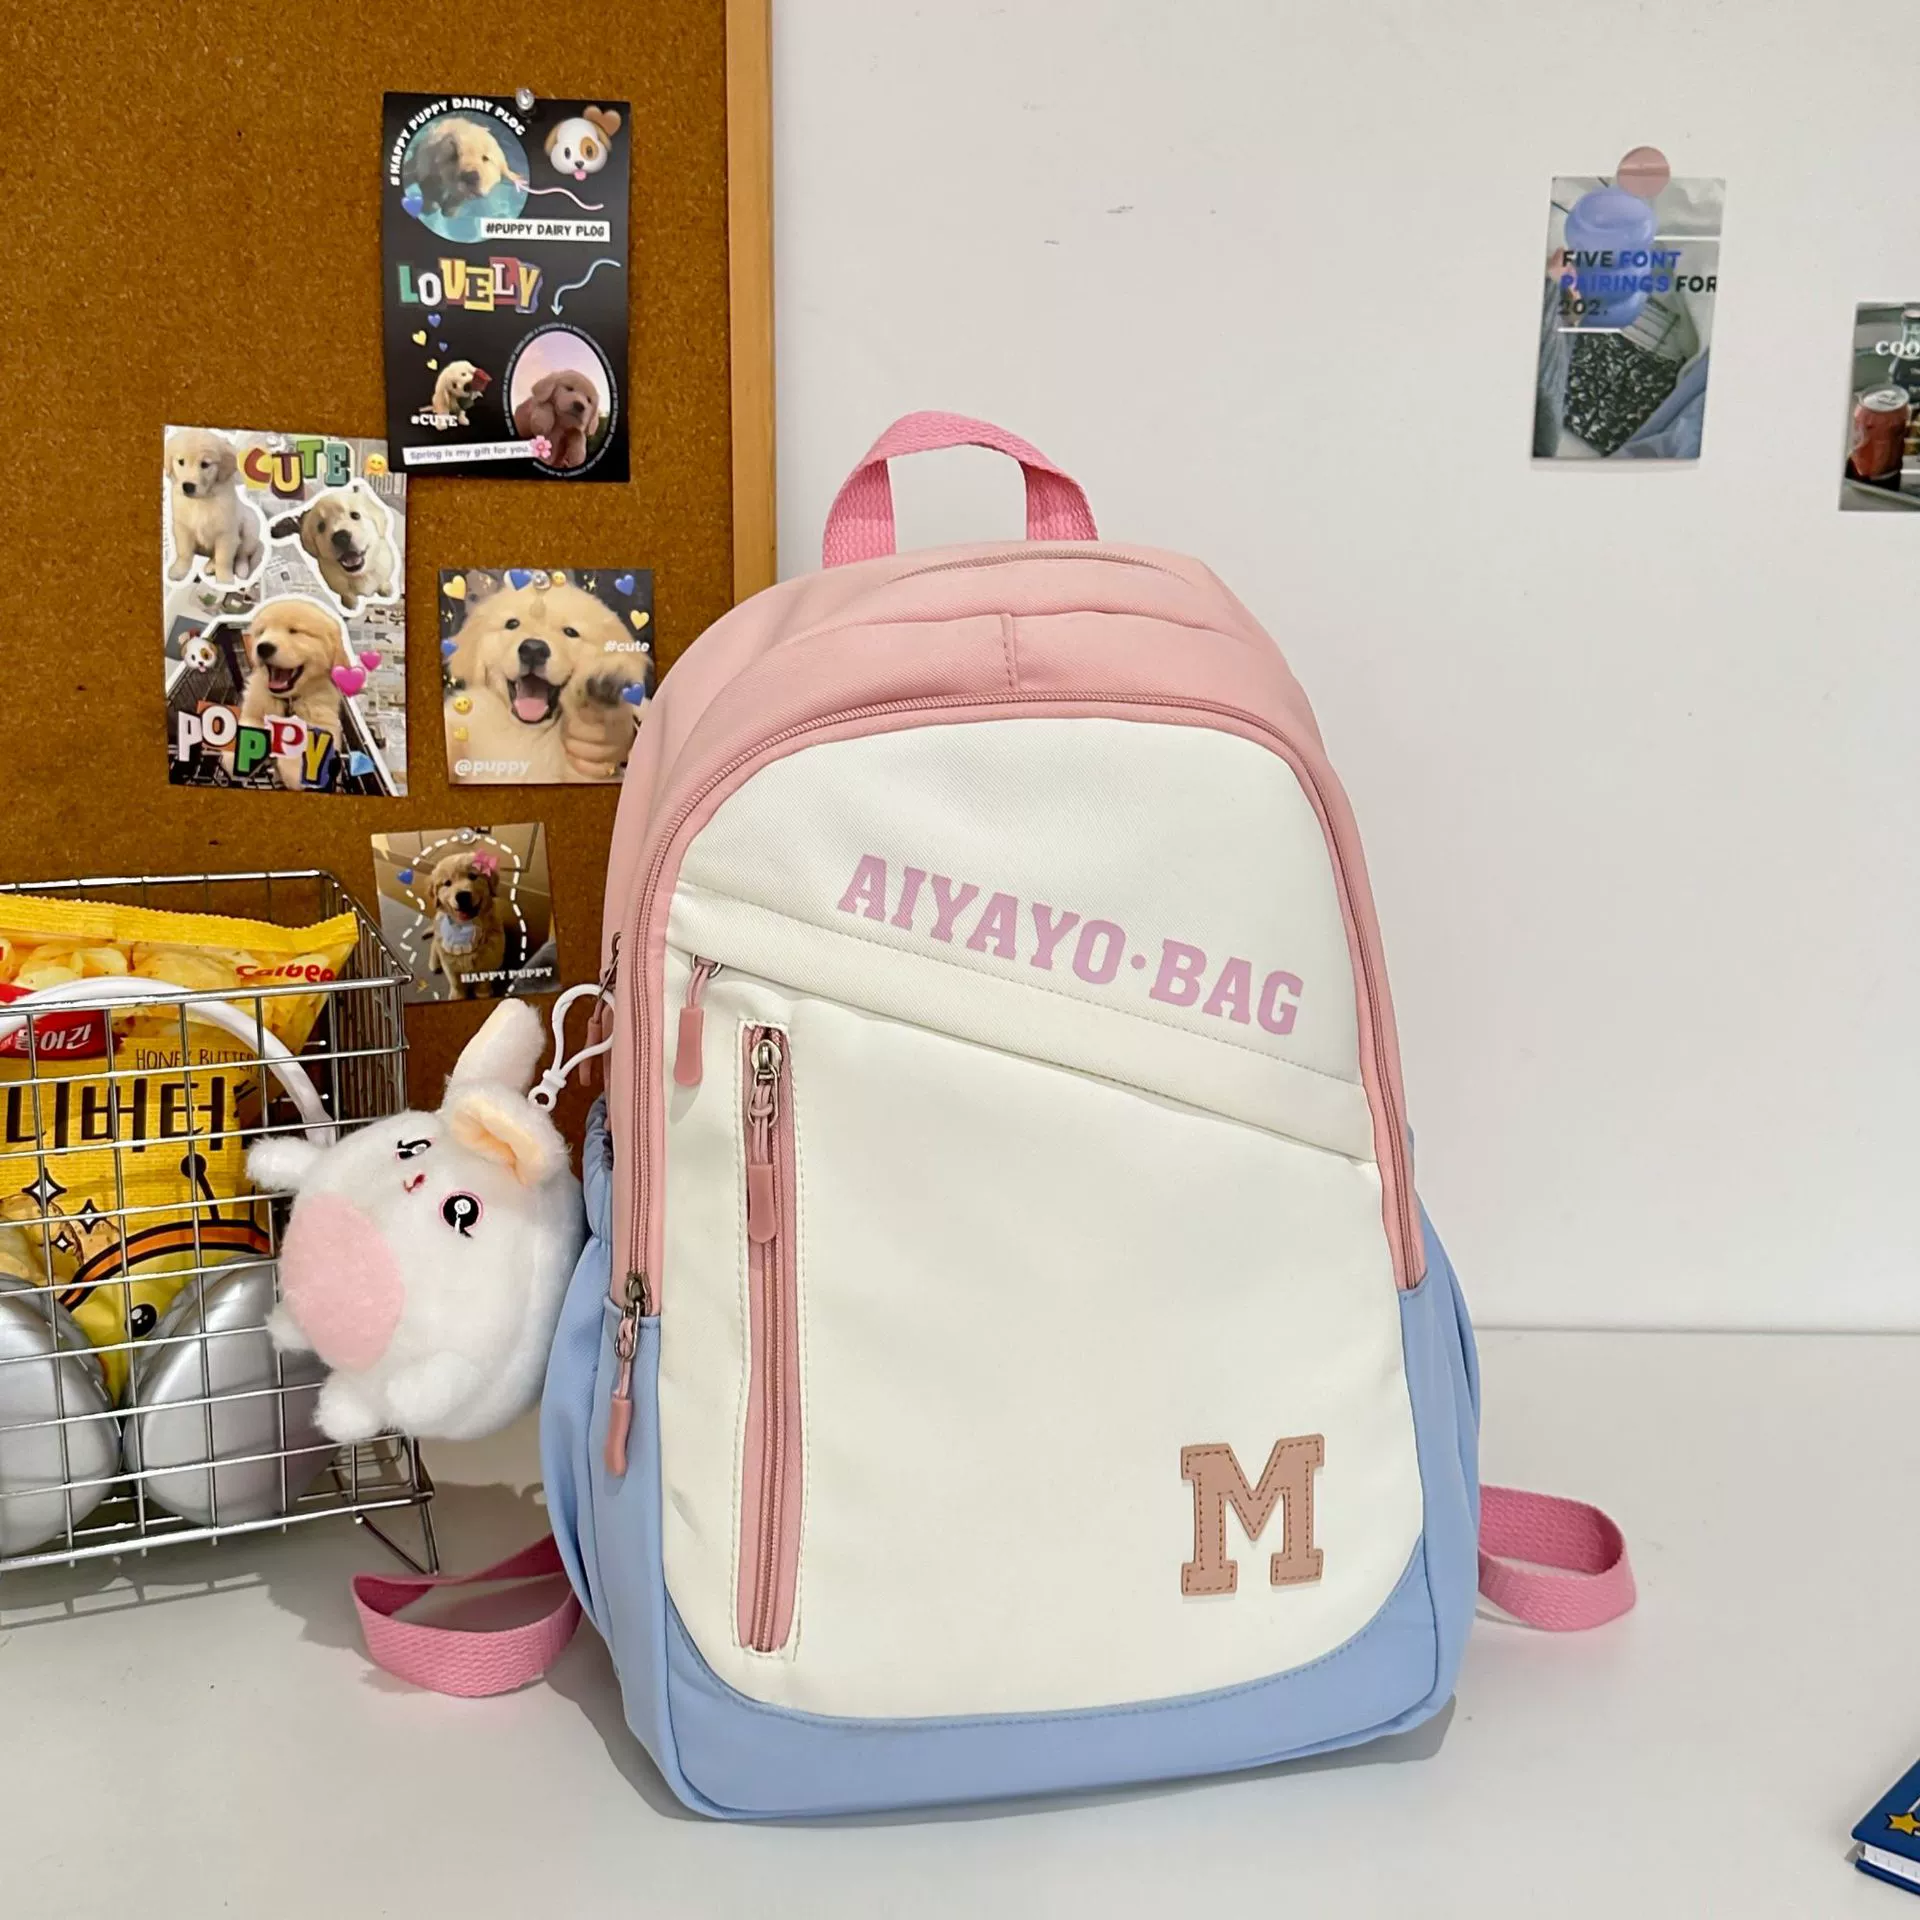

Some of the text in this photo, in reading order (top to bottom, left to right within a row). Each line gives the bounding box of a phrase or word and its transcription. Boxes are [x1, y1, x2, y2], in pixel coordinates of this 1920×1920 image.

[408, 100, 448, 130] PUPPY
[451, 97, 493, 113] DAIRY
[486, 222, 605, 237] #PUPPY DAIRY PLOG
[1562, 250, 1682, 269] FIVE FONT
[398, 257, 541, 312] LOVELY
[1560, 274, 1717, 293] PAIRINGS FOR
[410, 450, 442, 461] Spring
[445, 448, 453, 456] is
[456, 449, 471, 459] my
[474, 446, 491, 458] gift
[494, 446, 508, 454] for
[242, 439, 351, 493] CUTE
[603, 639, 650, 654] #cute
[178, 705, 332, 783] POPPY
[454, 758, 531, 777] @puppy
[460, 967, 553, 983] HAPPY PUPPY
[136, 1048, 191, 1071] HONE
[1181, 1433, 1325, 1596] M
